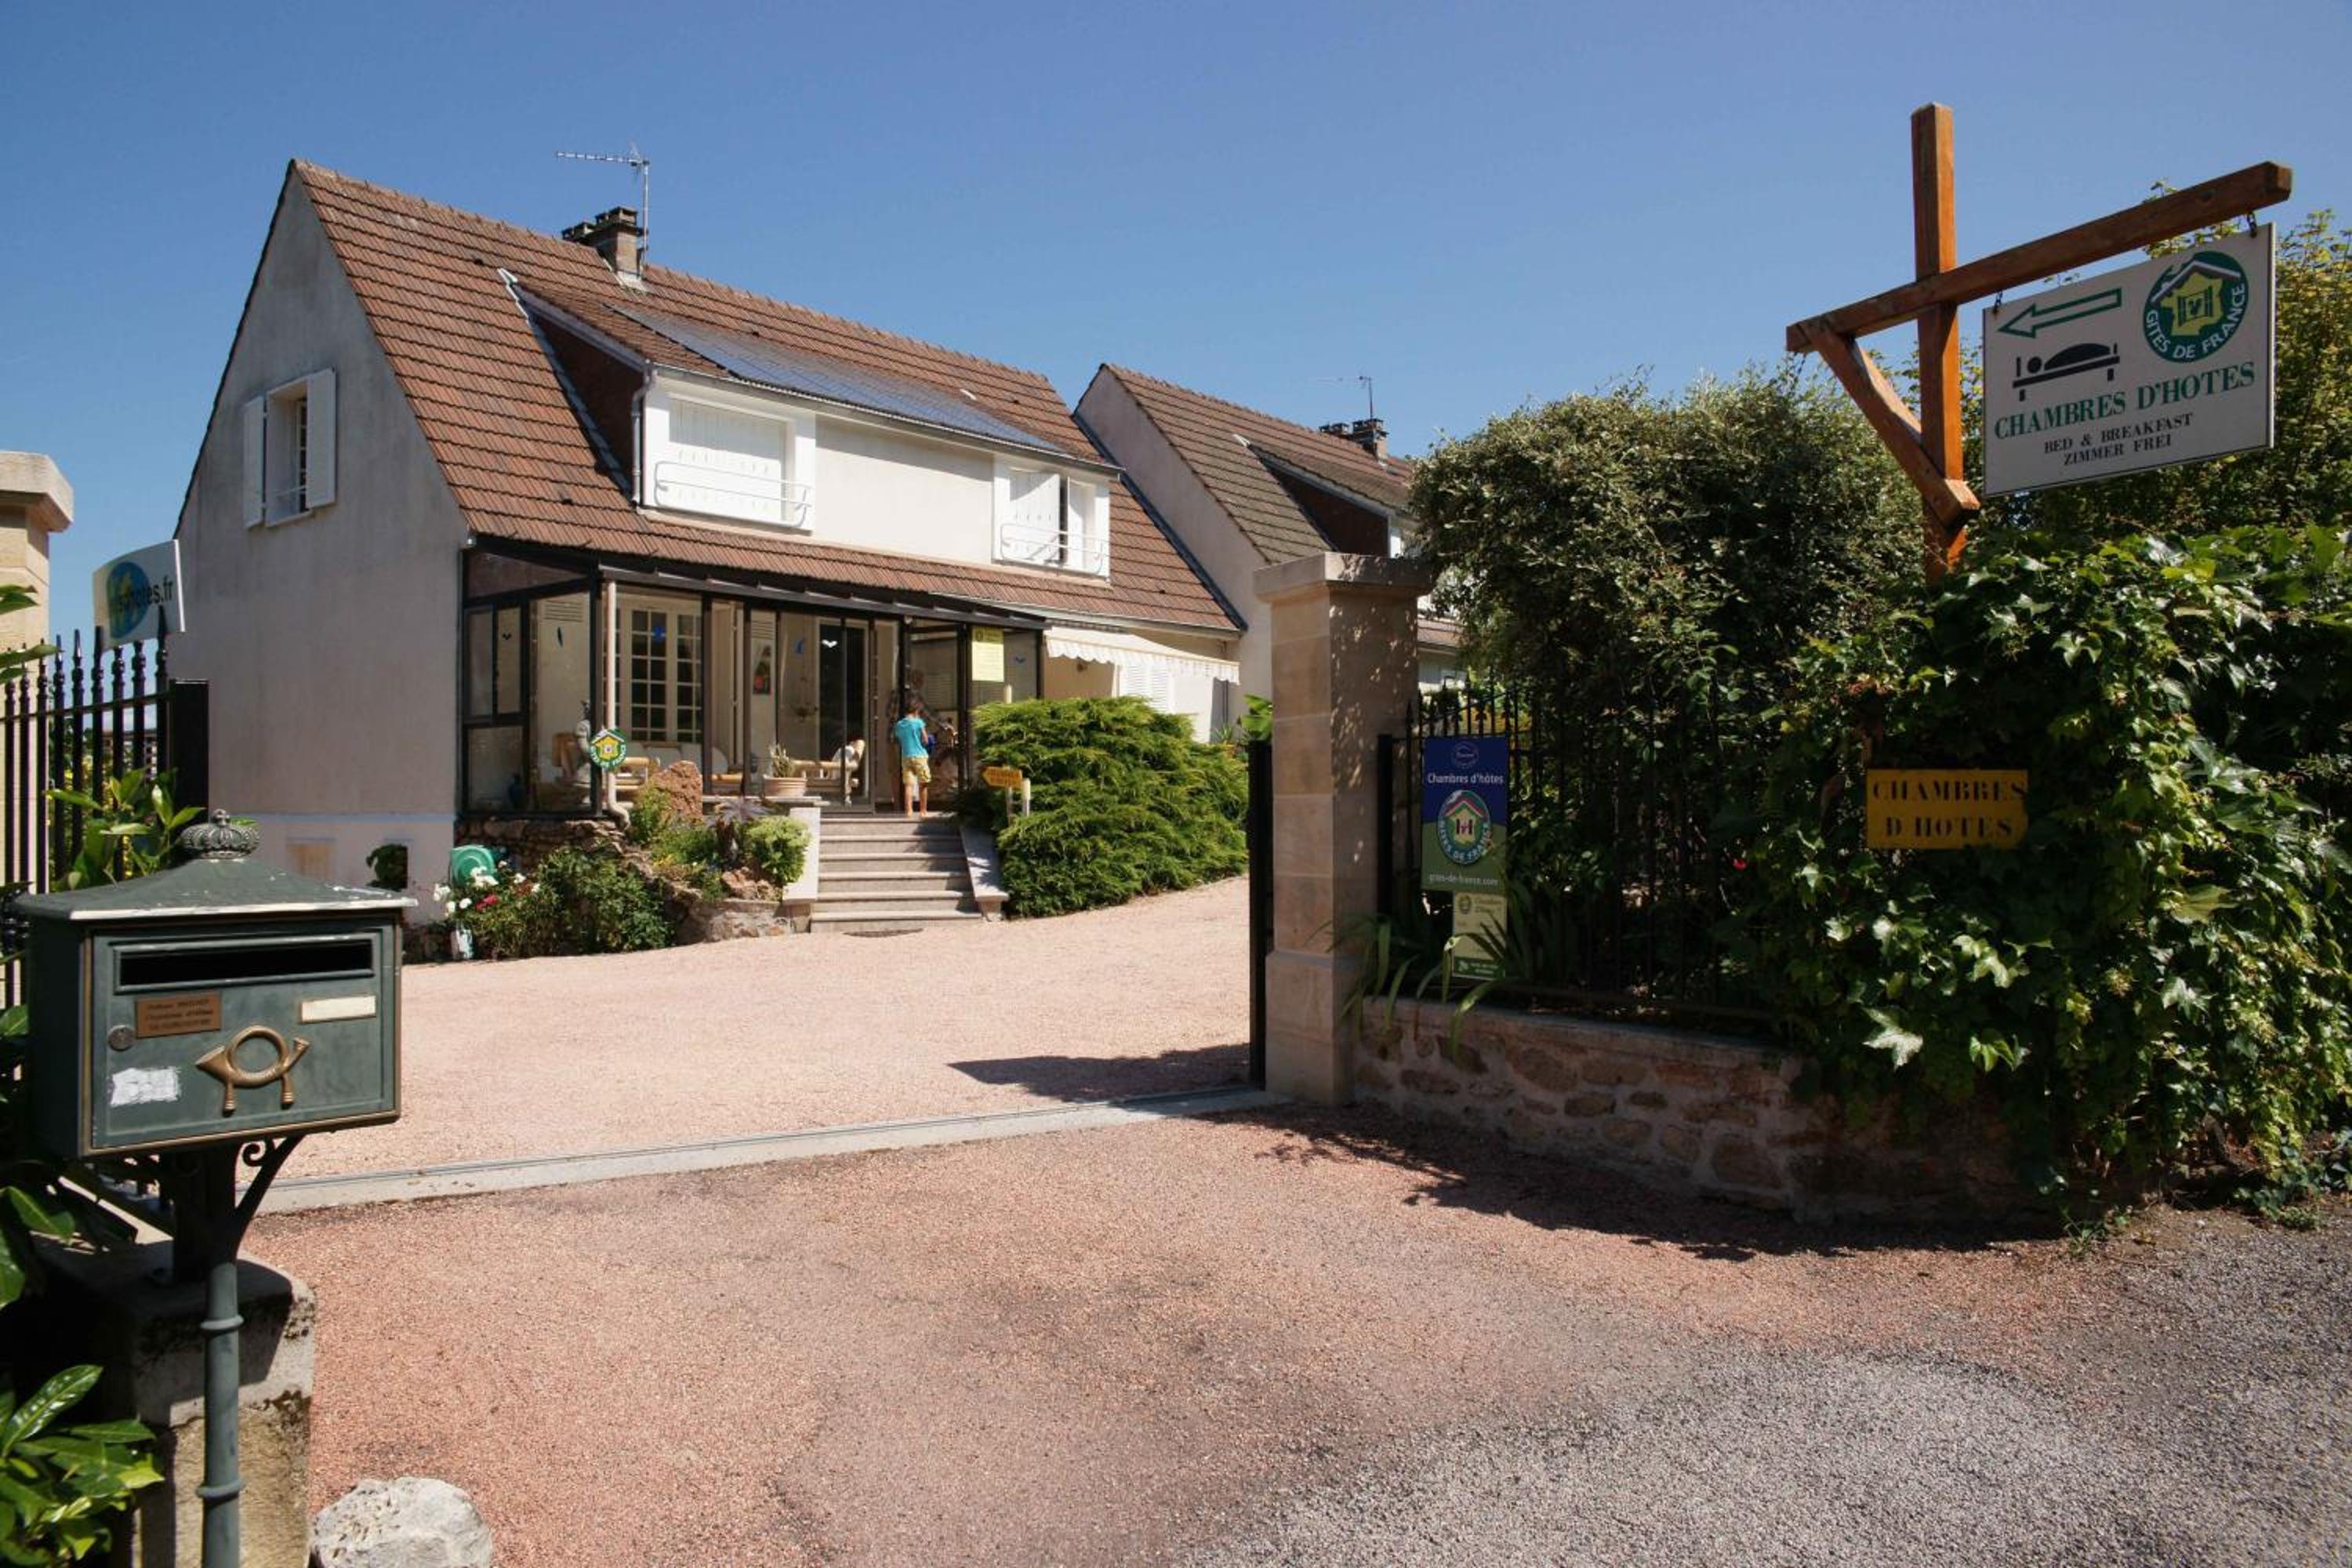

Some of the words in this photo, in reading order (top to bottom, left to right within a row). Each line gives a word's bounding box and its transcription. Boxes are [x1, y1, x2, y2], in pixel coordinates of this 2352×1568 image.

[2146, 310, 2170, 352] GITES
[2172, 345, 2196, 358] DE
[2201, 283, 2245, 353] FRANCE
[1994, 392, 2125, 440] CHAMBRES
[2138, 361, 2255, 410] D'HOTES
[2044, 437, 2073, 454] BED
[2081, 434, 2092, 447] &
[2101, 412, 2193, 443] BREAKFAST
[2063, 443, 2125, 466] ZIMMER
[2133, 434, 2171, 452] FREI
[1427, 772, 1468, 783] Chambres
[1872, 780, 2027, 801] CHAMBRES
